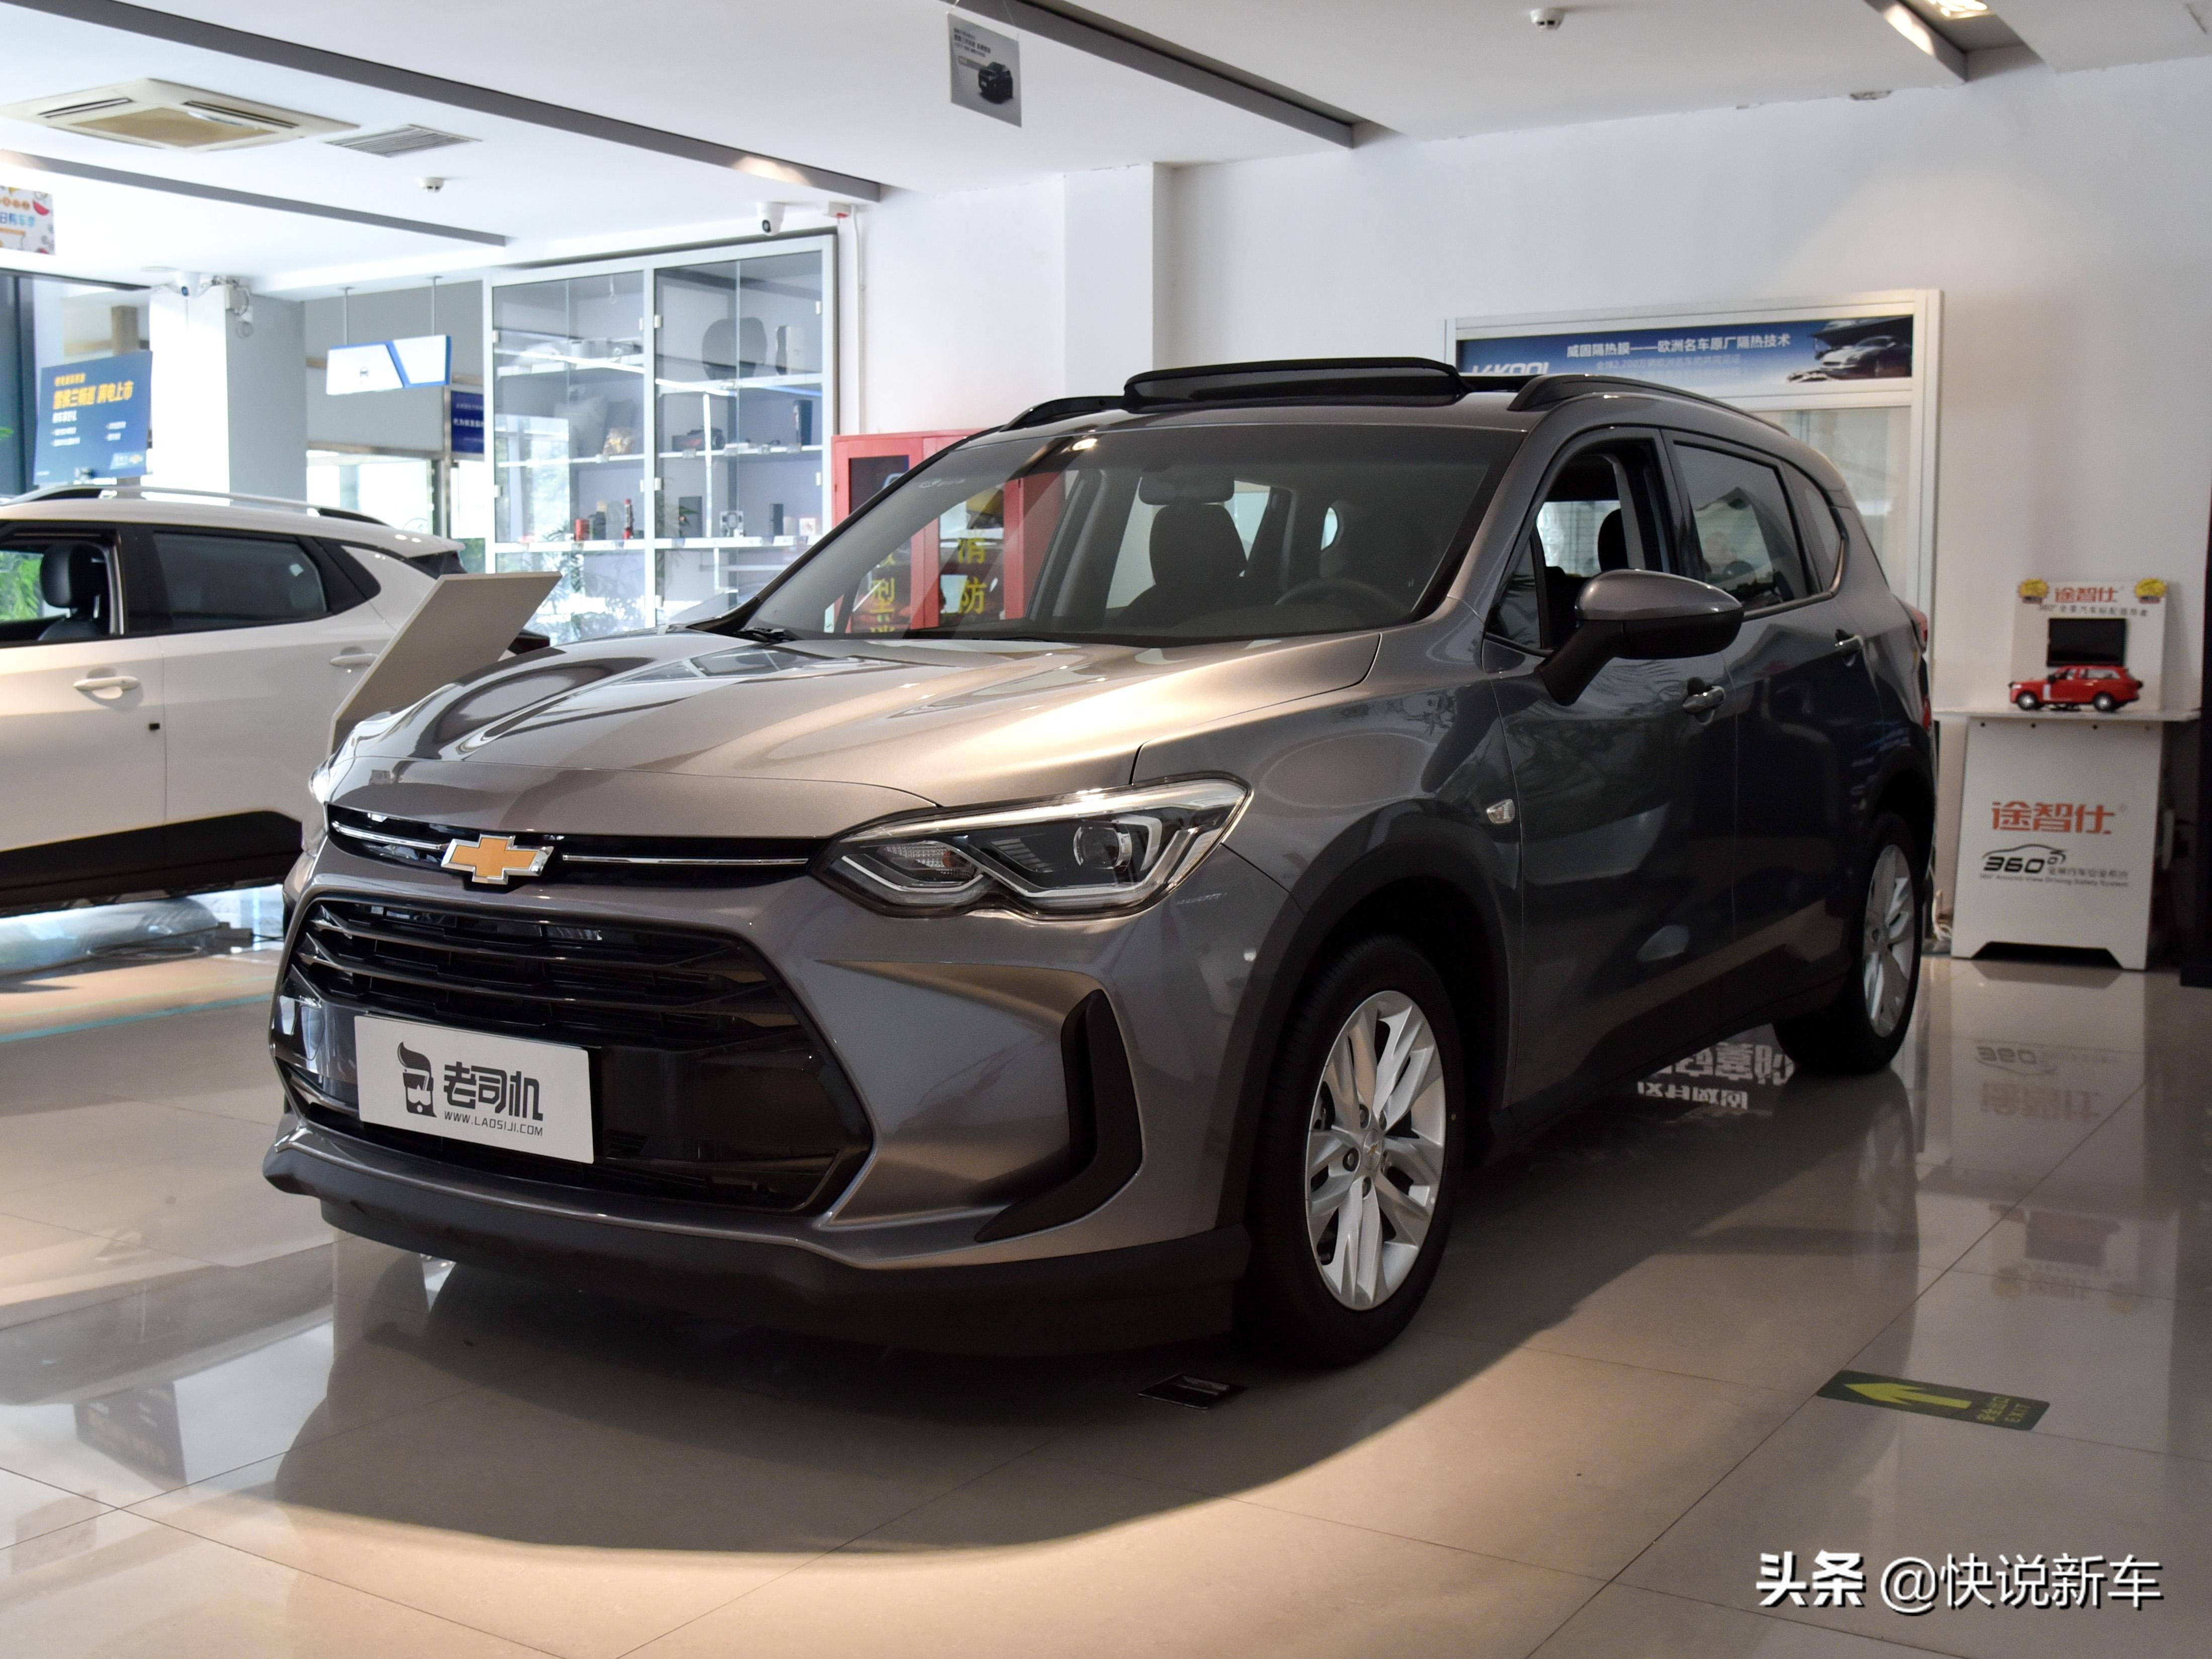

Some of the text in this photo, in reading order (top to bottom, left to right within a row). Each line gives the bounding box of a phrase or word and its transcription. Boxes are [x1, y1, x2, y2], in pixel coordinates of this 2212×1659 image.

[2055, 587, 2118, 603] 途智仕
[1992, 801, 2115, 835] 途智仕
[443, 1061, 543, 1121] 老司机
[444, 1111, 543, 1137] WWW.LAOSIJI.COM
